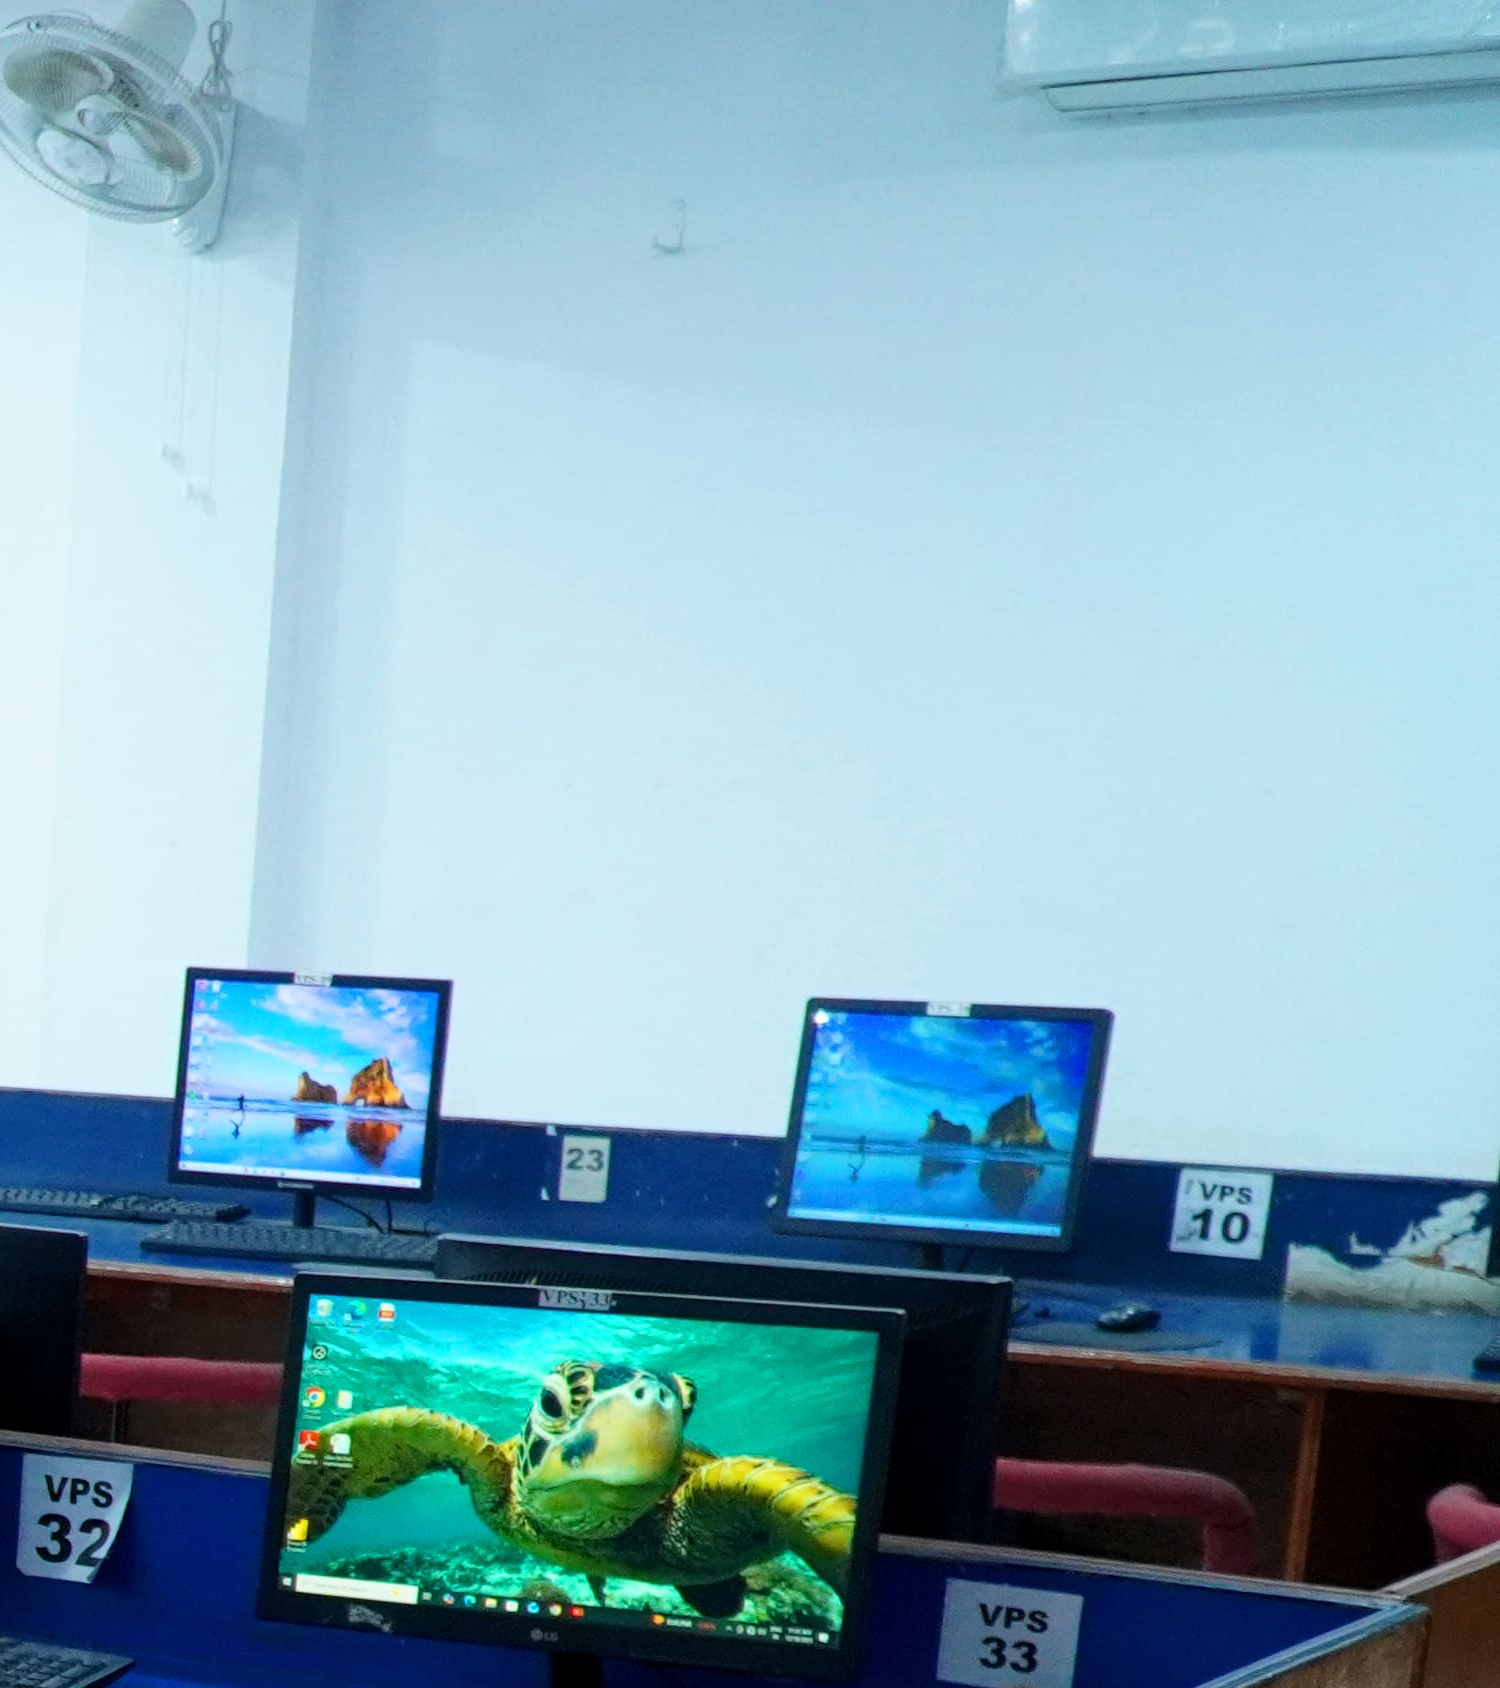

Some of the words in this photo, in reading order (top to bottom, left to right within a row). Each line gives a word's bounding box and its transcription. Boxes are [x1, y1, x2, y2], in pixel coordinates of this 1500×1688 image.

[566, 1147, 605, 1173] 23
[1197, 1180, 1253, 1206] VPS
[1191, 1208, 1251, 1246] 10
[43, 1474, 114, 1509] VPS
[35, 1512, 112, 1567] 32
[978, 1602, 1049, 1634] VPS
[978, 1636, 1040, 1675] 33
